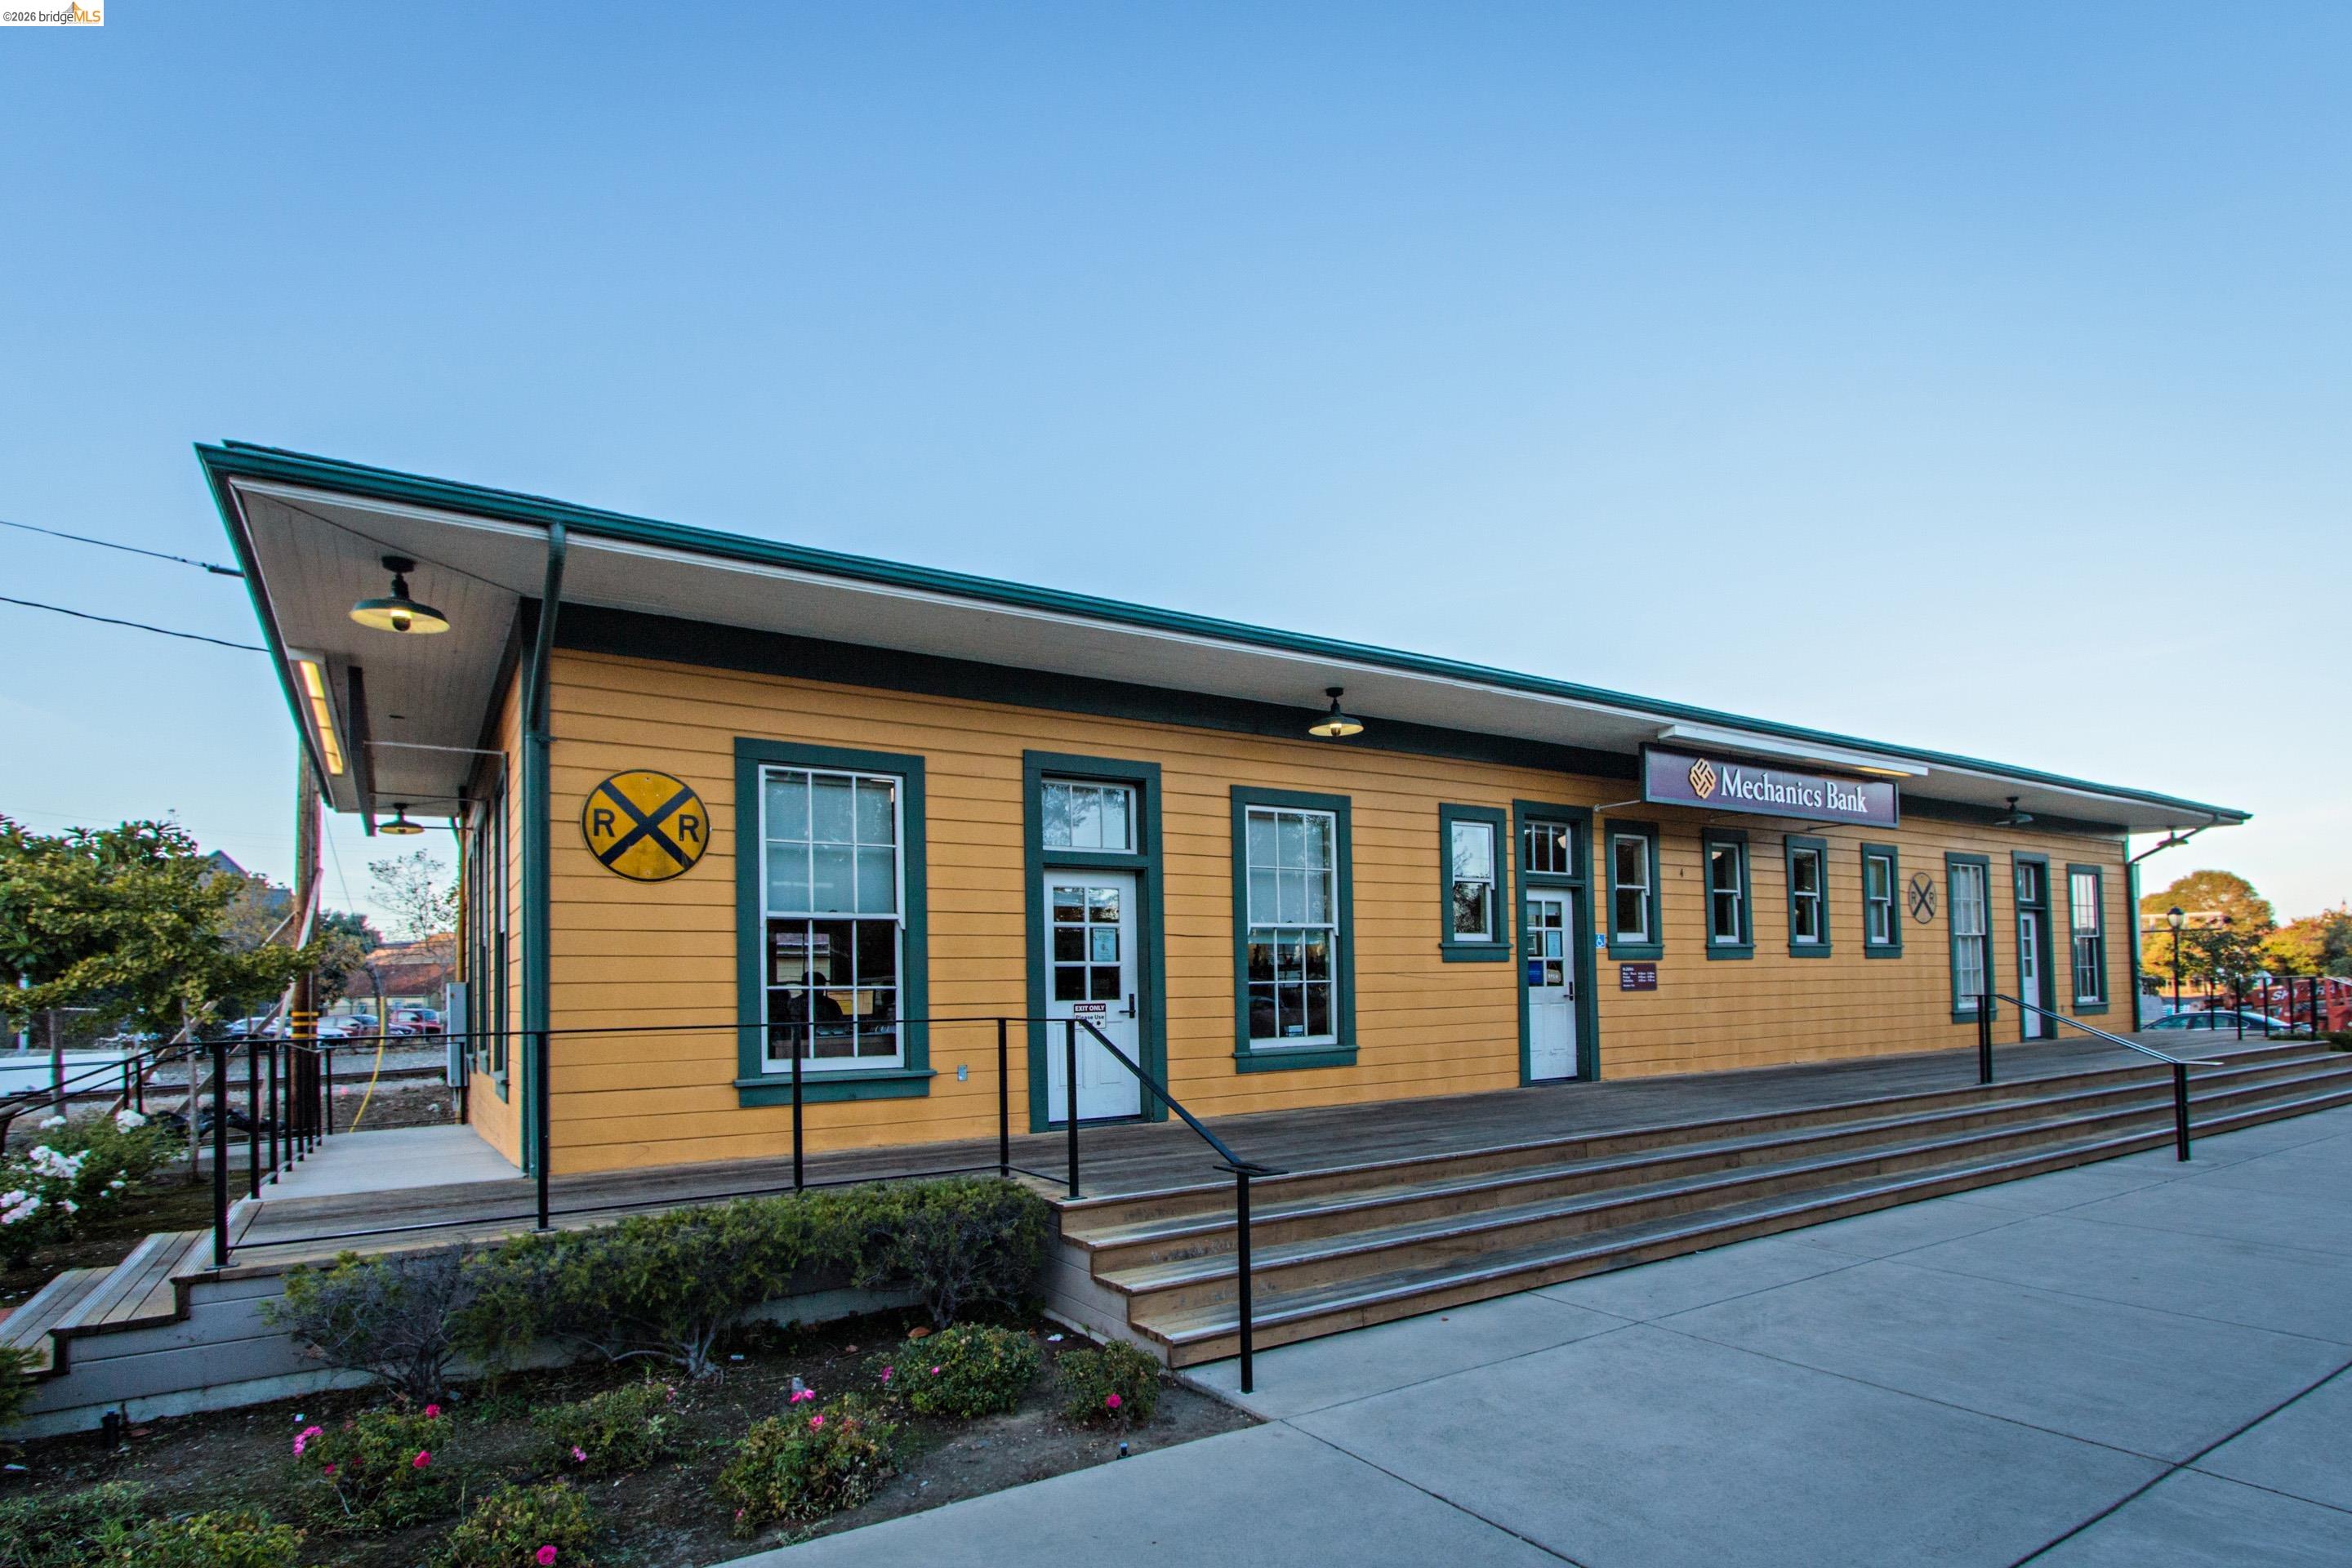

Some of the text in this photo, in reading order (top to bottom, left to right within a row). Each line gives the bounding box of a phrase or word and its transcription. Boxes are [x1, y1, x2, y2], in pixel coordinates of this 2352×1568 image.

[1721, 766, 1869, 813] Mechanics Bank
[593, 808, 700, 843] R R
